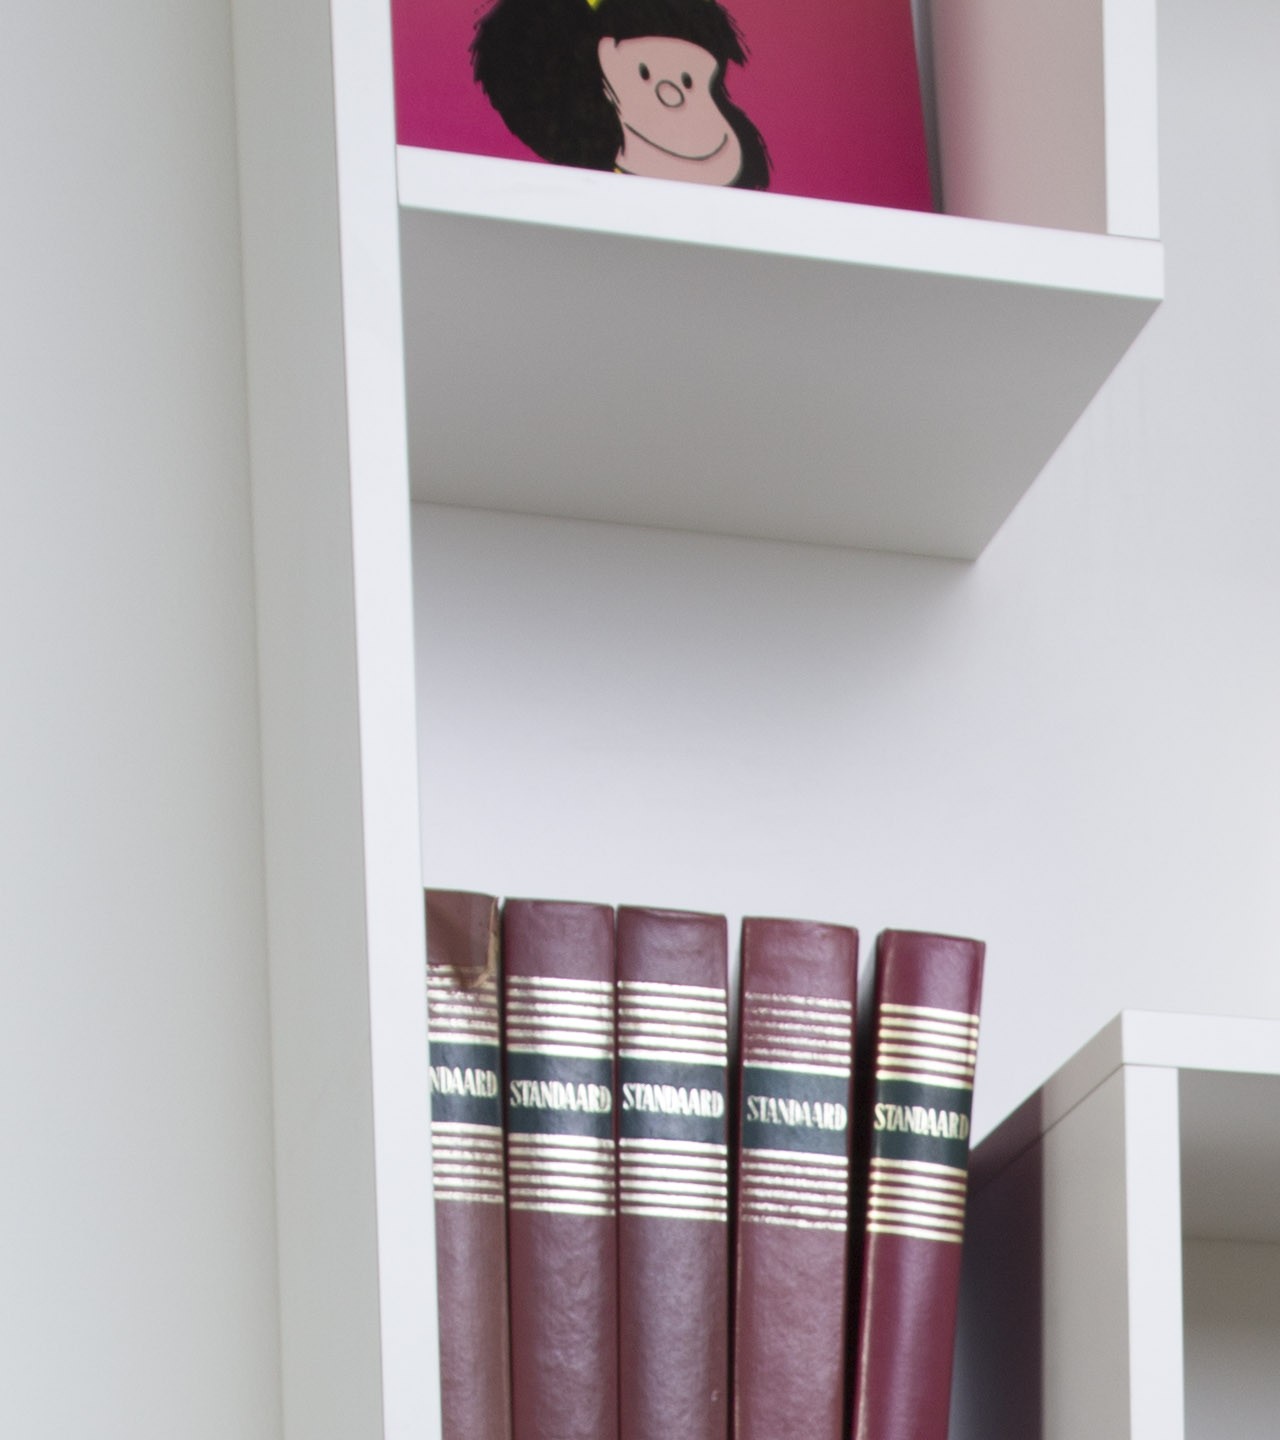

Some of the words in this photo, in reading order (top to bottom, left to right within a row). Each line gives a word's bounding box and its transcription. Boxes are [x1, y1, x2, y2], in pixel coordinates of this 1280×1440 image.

[510, 1079, 613, 1113] STANDAARD
[622, 1083, 726, 1118] STANDAARD
[747, 1095, 848, 1131] STANDAARD
[874, 1102, 970, 1140] STANDAARD
